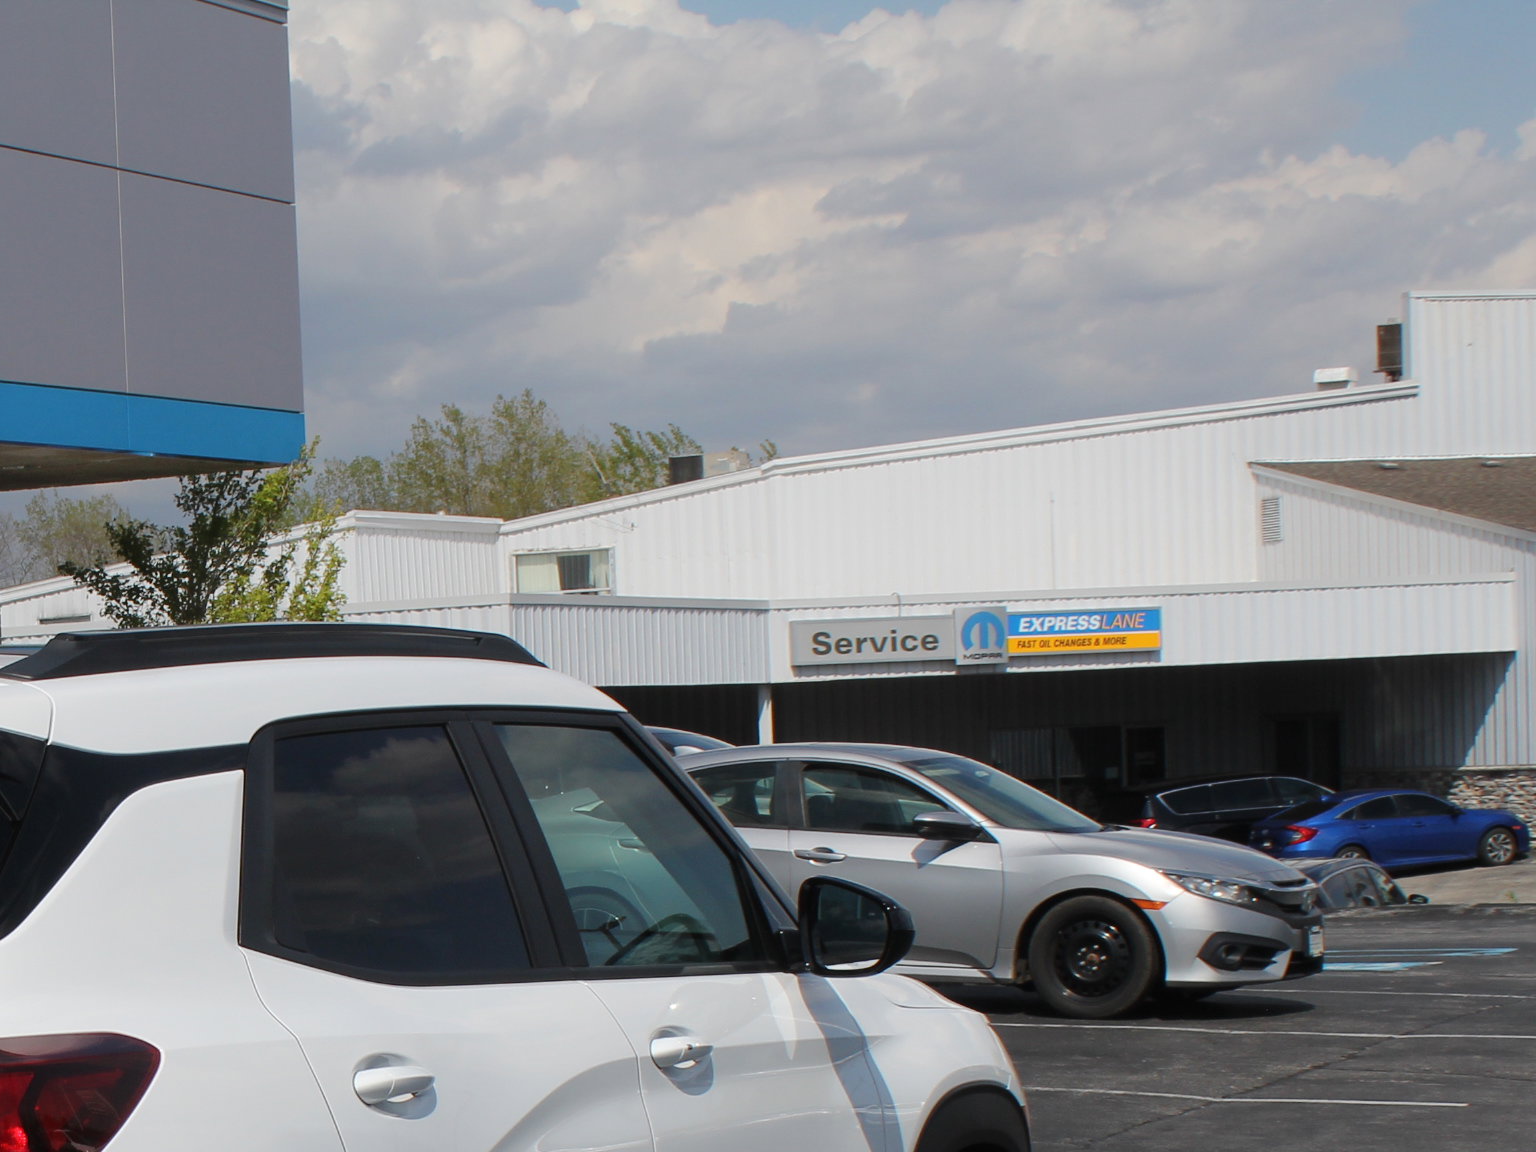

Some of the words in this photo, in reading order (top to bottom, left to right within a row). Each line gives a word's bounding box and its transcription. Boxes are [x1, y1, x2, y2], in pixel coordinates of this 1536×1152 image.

[811, 629, 940, 656] Service
[1017, 639, 1037, 649] FAST
[1039, 639, 1052, 648] OIL
[1054, 637, 1092, 648] CHANGES
[1094, 637, 1100, 646] &
[1102, 636, 1127, 646] MORE
[963, 652, 1003, 660] MOPAR
